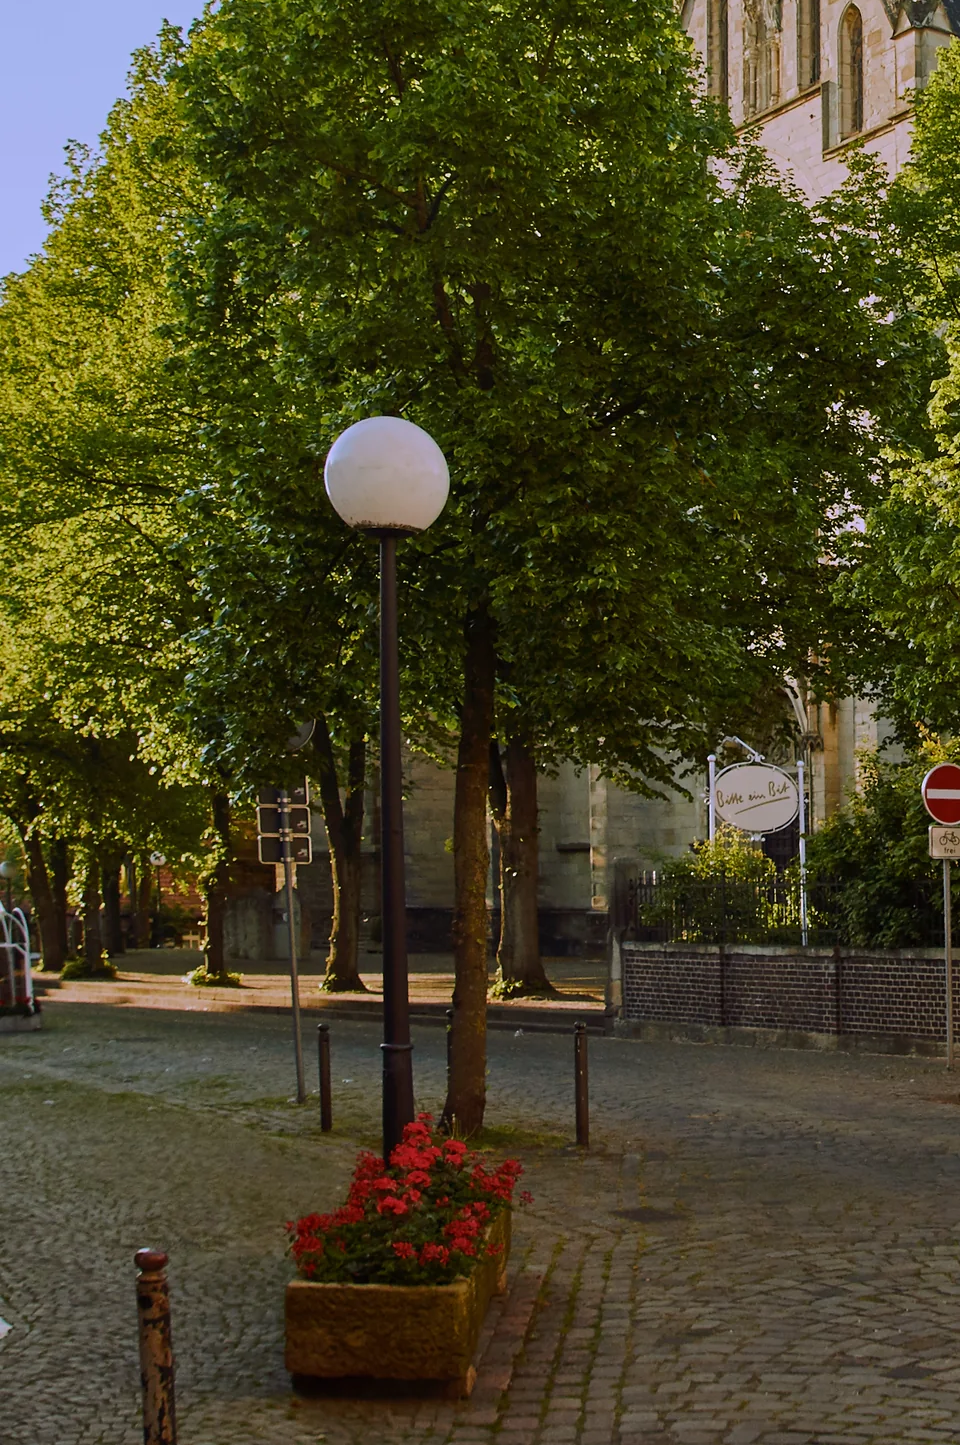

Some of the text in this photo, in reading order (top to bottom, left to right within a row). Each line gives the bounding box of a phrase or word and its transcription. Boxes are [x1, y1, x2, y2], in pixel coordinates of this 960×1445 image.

[716, 782, 789, 807] Bitte ein Bit
